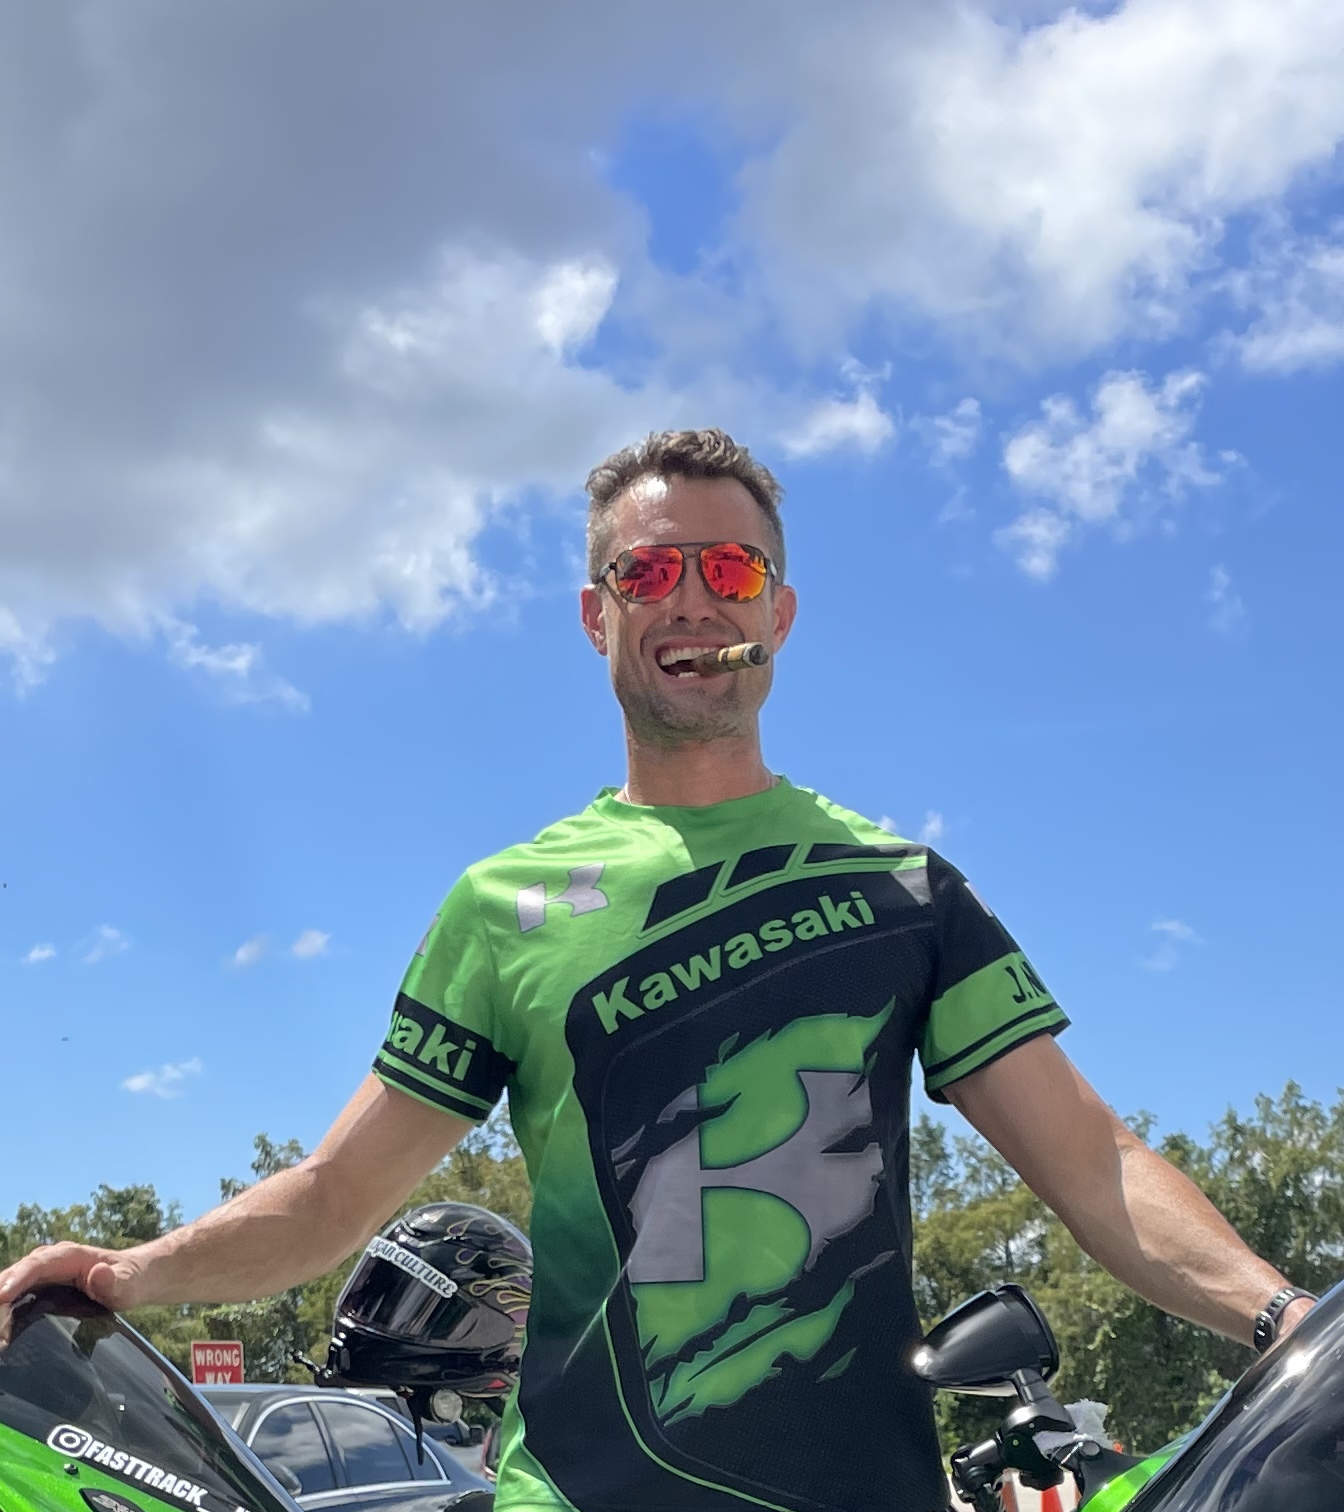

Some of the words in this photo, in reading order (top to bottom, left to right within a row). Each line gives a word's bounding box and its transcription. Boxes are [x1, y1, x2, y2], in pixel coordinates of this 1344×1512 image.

[591, 890, 875, 1035] Kawasaki
[387, 1010, 477, 1081] aki
[394, 1250, 458, 1297] CULTURE
[195, 1348, 240, 1367] WRONG
[205, 1371, 232, 1385] WAY
